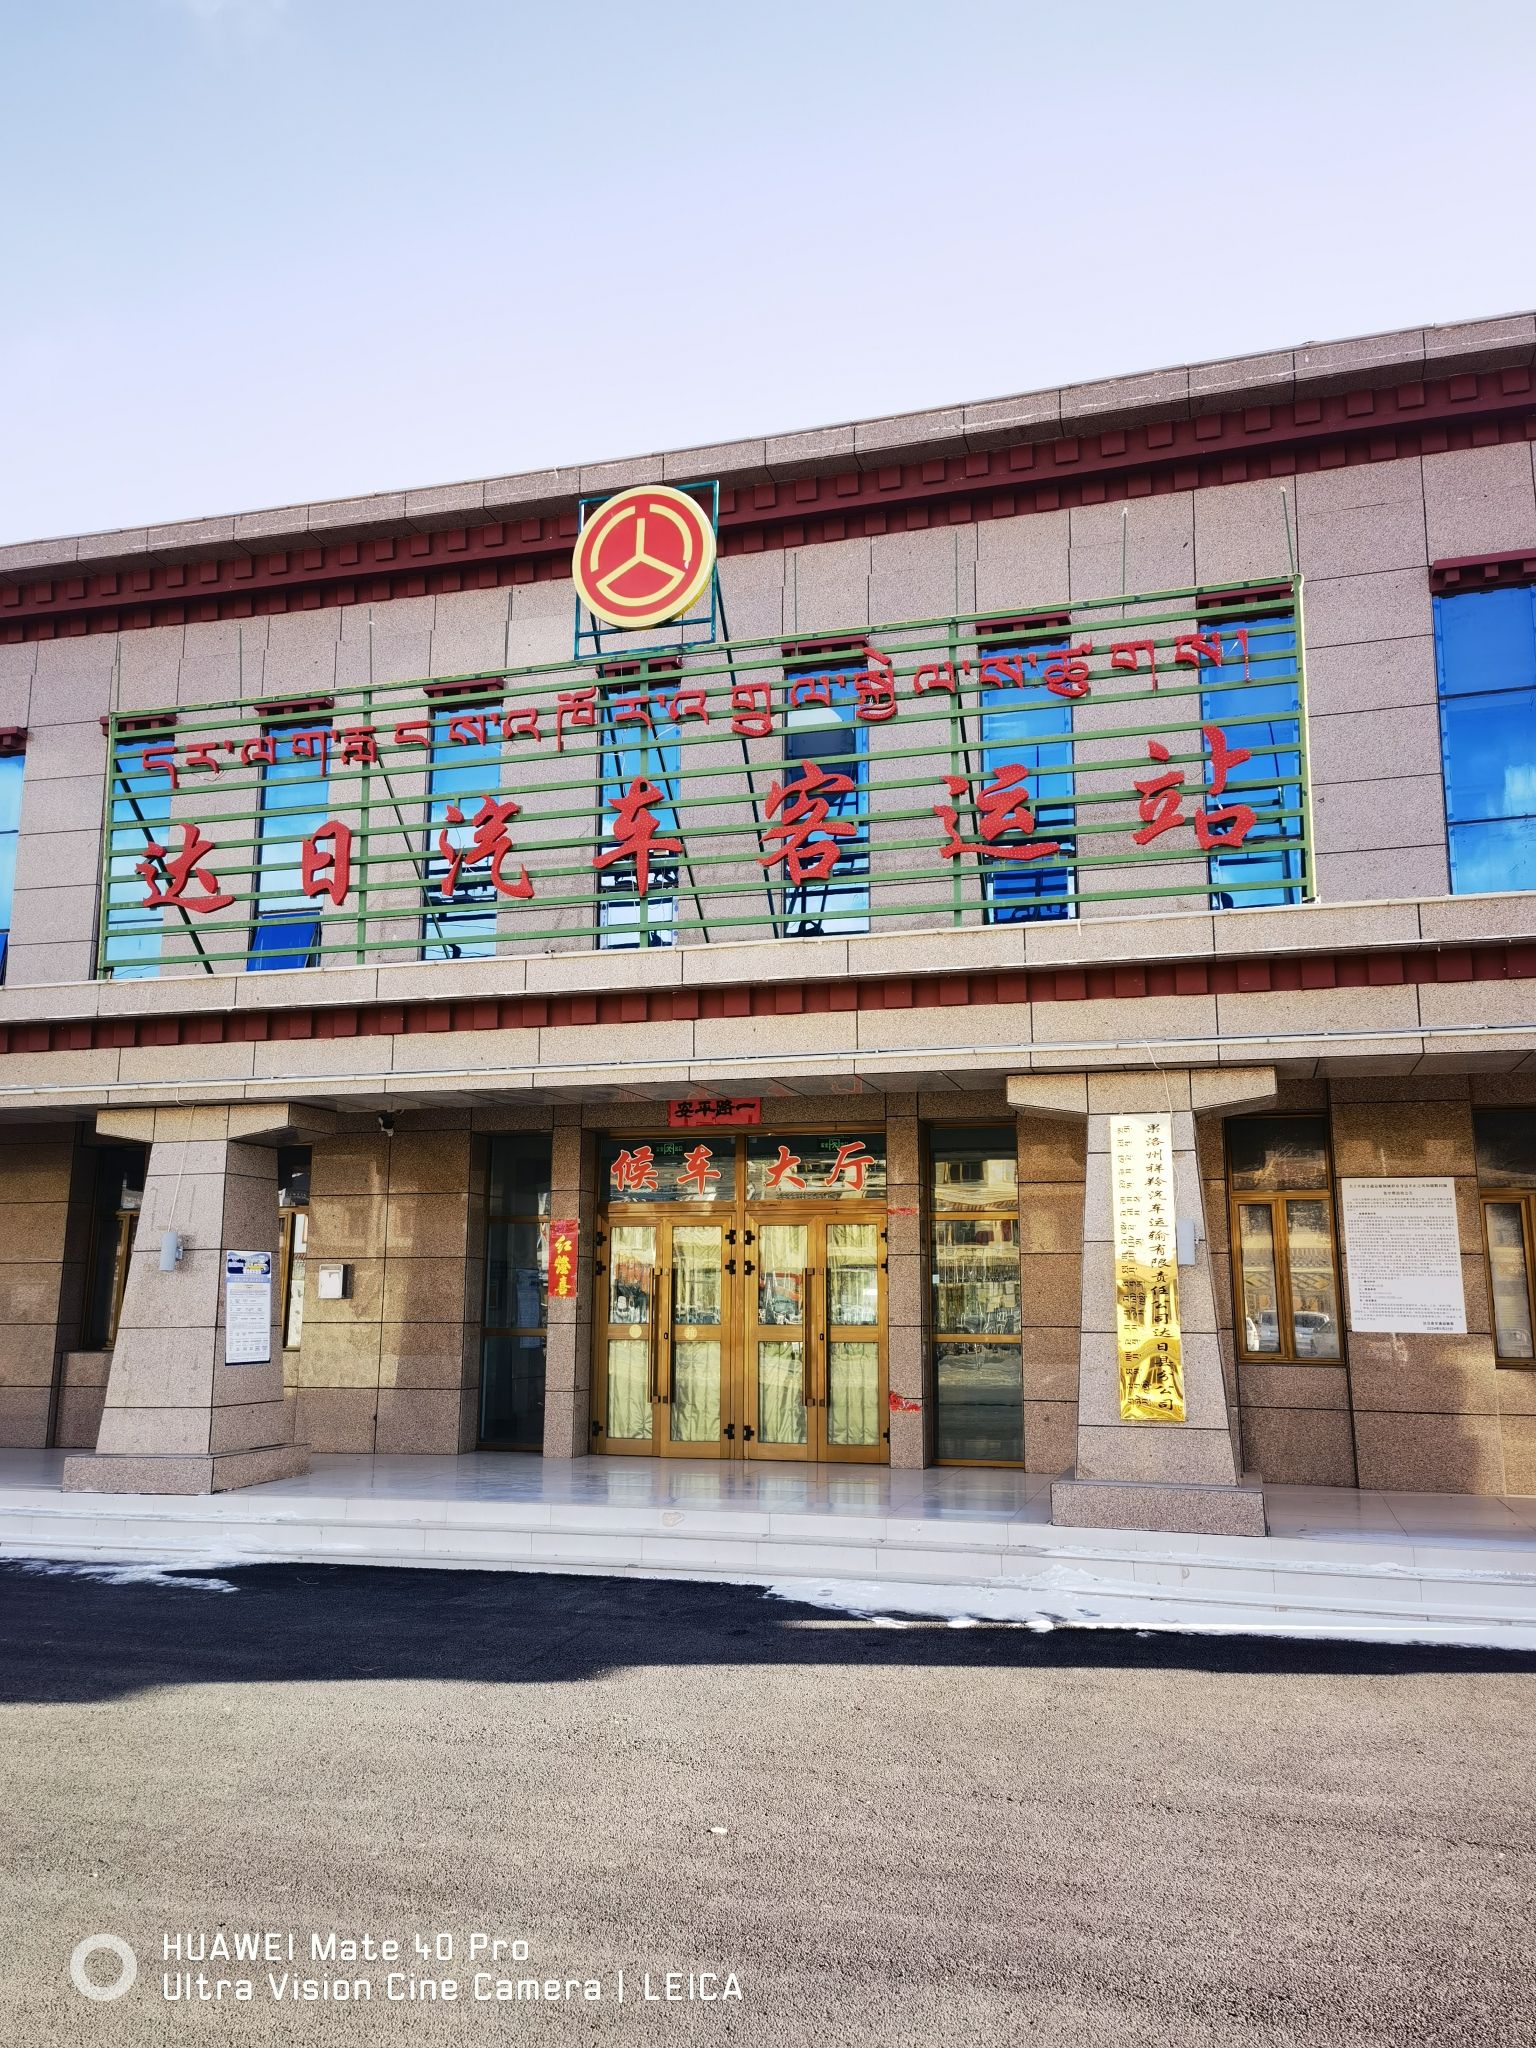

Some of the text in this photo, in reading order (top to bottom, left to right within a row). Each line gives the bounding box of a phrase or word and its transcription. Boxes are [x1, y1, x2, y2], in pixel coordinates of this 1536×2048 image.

[135, 726, 1257, 913] 达日汽车客运站
[610, 1141, 874, 1195] 候车大厅
